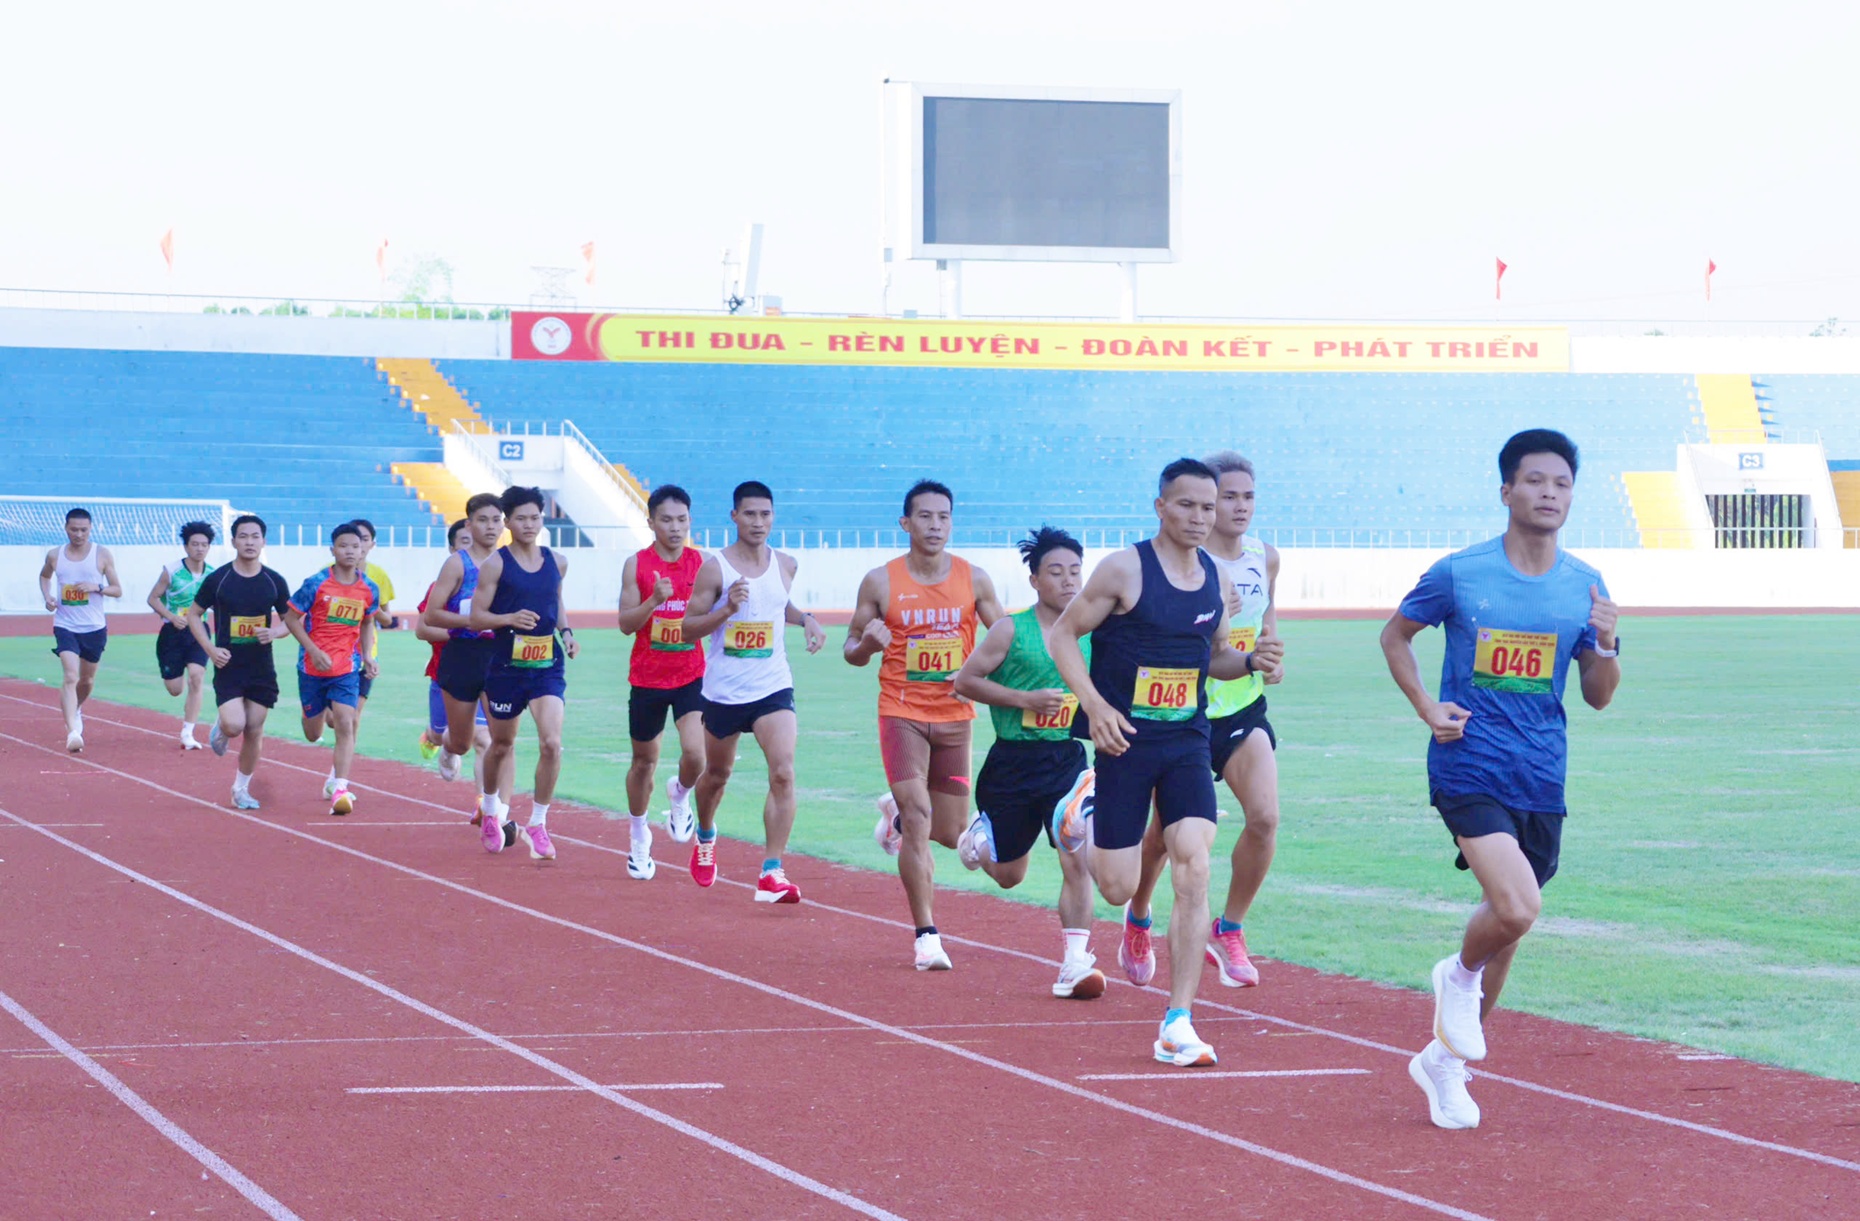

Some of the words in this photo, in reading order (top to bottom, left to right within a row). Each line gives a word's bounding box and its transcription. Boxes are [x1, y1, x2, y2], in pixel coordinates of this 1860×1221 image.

[636, 330, 695, 349] THI
[709, 332, 786, 351] ĐUA
[829, 331, 905, 353] RÈN
[920, 332, 1040, 358] LUYỆN
[1082, 335, 1188, 357] ĐOÀN
[1204, 334, 1273, 357] KẾT
[1315, 338, 1413, 358] PHÁT
[1426, 334, 1539, 358] TRIỂN
[502, 443, 521, 457] C2
[1742, 454, 1760, 467] C3
[335, 604, 359, 620] 071
[900, 607, 961, 626] VNRUN
[661, 627, 684, 644] 00
[735, 630, 766, 649] 026
[521, 644, 548, 661] 002
[918, 650, 952, 672] 041
[1490, 646, 1543, 678] 046
[1147, 681, 1188, 708] 048
[1035, 705, 1071, 728] 020
